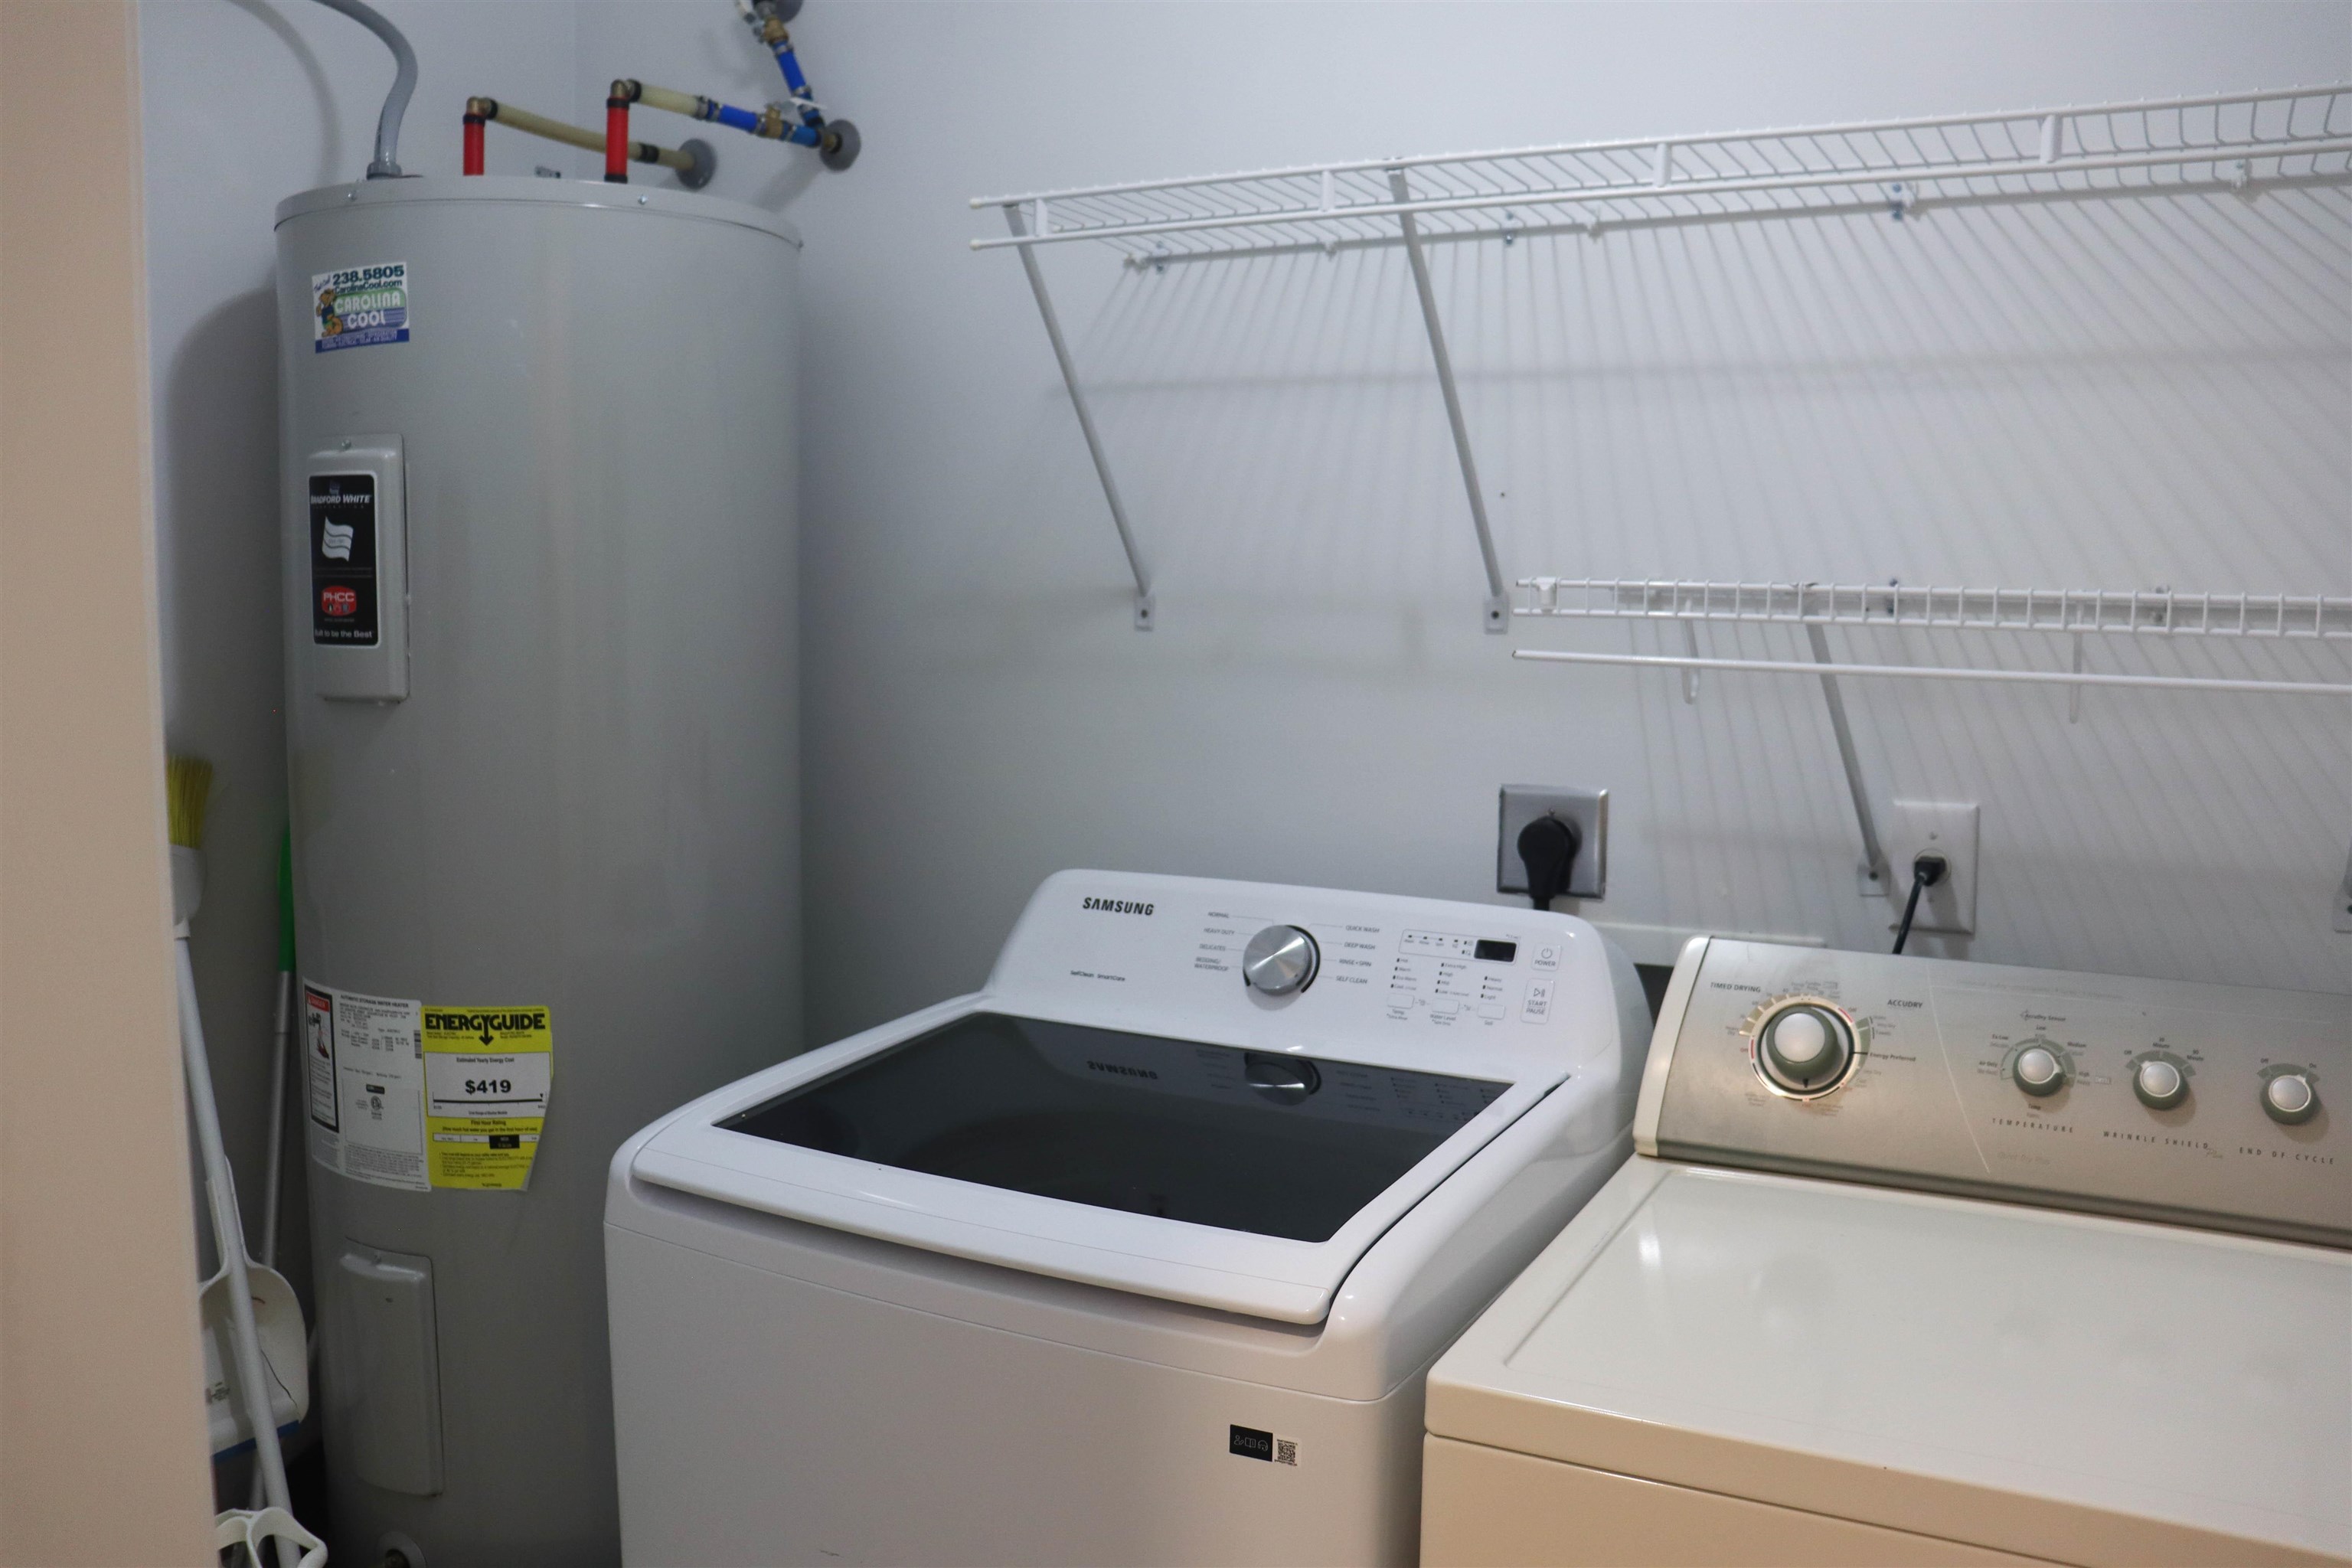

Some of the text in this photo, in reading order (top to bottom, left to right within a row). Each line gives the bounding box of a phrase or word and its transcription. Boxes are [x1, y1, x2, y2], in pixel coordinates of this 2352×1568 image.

[332, 265, 404, 286] 238.5805
[335, 279, 403, 295] CarolinaCool.com
[335, 291, 400, 313] CAROLINA
[348, 310, 386, 328] COOL
[343, 495, 371, 504] WHITE
[323, 592, 355, 602] PHCC
[332, 629, 339, 638] be
[354, 630, 372, 639] Best
[1083, 897, 1154, 916] SAMSUNG
[1199, 943, 1227, 952] DELICATES
[1534, 959, 1556, 967] POWER
[1710, 982, 1761, 993] TIMED DRYING
[1887, 999, 1923, 1008] ACCUDRY
[425, 1013, 546, 1031] ENERGYGUIDE
[1890, 1054, 1916, 1062] Preferred
[465, 1079, 511, 1096] $419
[1992, 1118, 2073, 1133] TEMPERATURE
[2104, 1131, 2208, 1149] WRINKLE SHIELD
[2239, 1147, 2262, 1155] END
[2295, 1154, 2334, 1165] CYCLE
